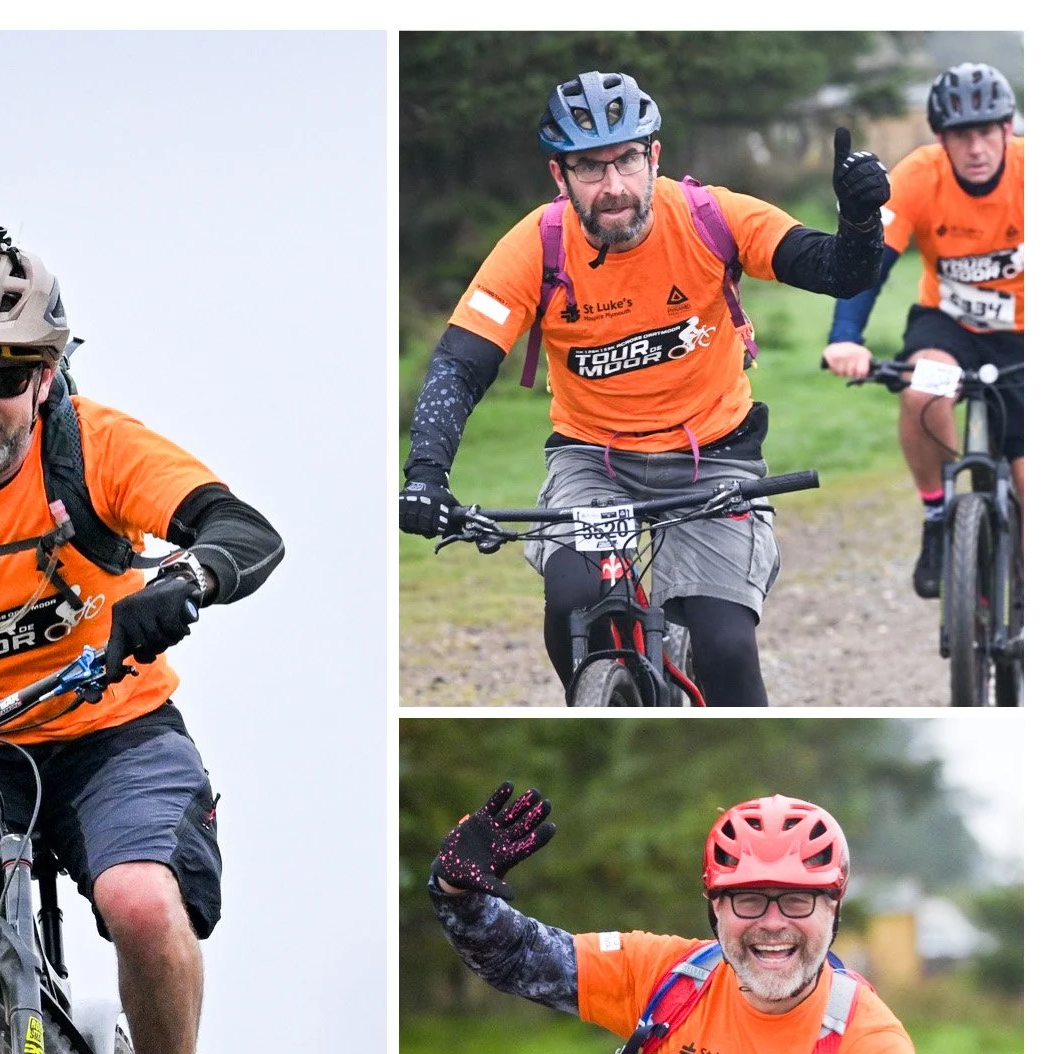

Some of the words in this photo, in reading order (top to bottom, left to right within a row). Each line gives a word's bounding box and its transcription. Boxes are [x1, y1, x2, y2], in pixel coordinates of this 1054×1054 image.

[584, 304, 594, 314] St
[597, 298, 633, 312] Luke's
[575, 340, 649, 366] TOUR
[650, 345, 663, 353] DE
[578, 352, 661, 377] MOOR
[18, 624, 35, 633] DE
